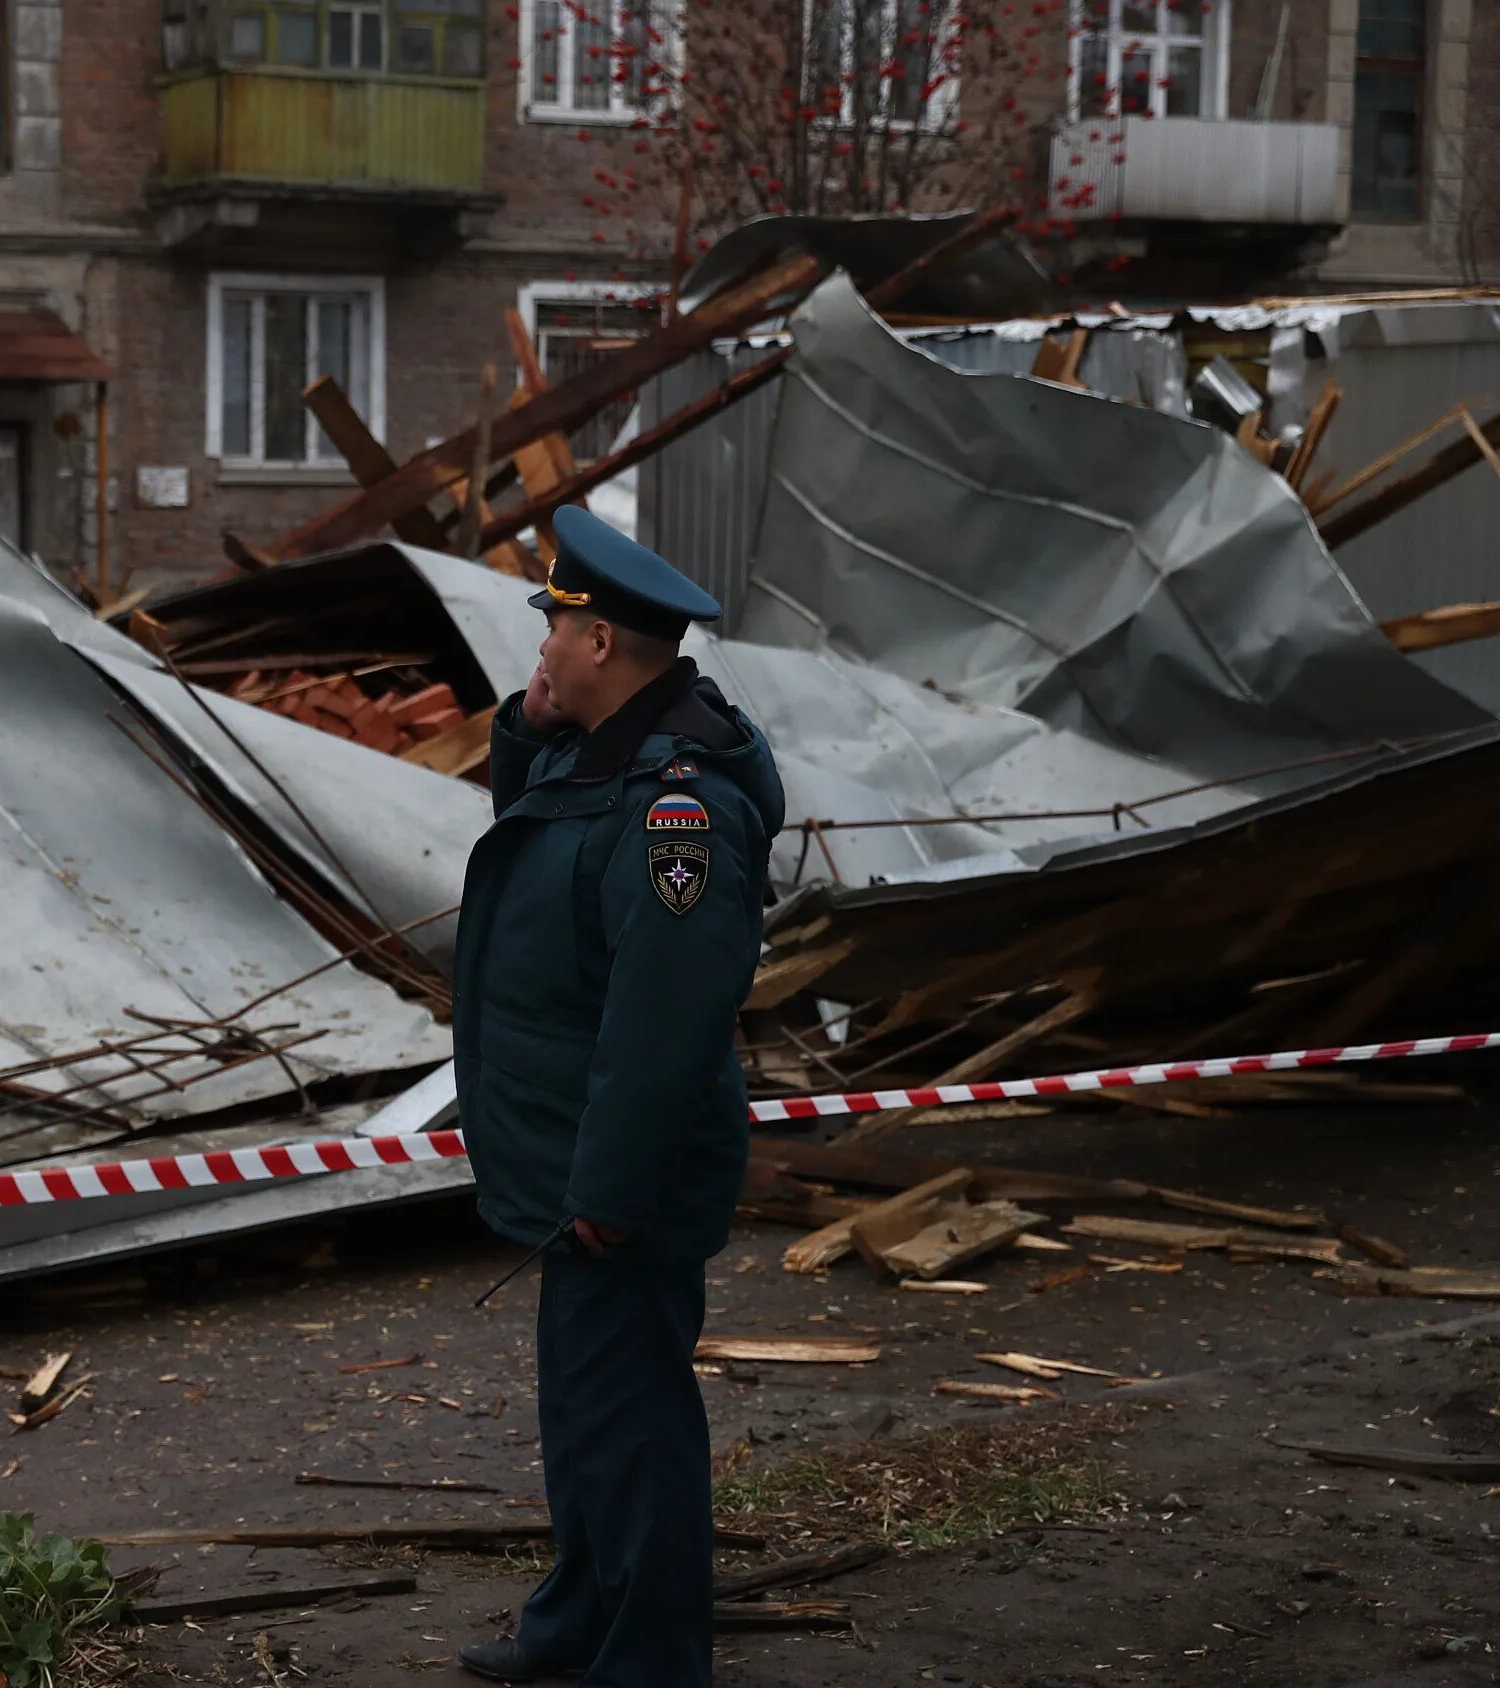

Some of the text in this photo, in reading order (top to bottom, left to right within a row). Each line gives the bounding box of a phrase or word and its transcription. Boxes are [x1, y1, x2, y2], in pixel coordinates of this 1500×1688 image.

[656, 818, 700, 827] RUSSIA
[653, 845, 705, 857] МЧС РОССИИ
